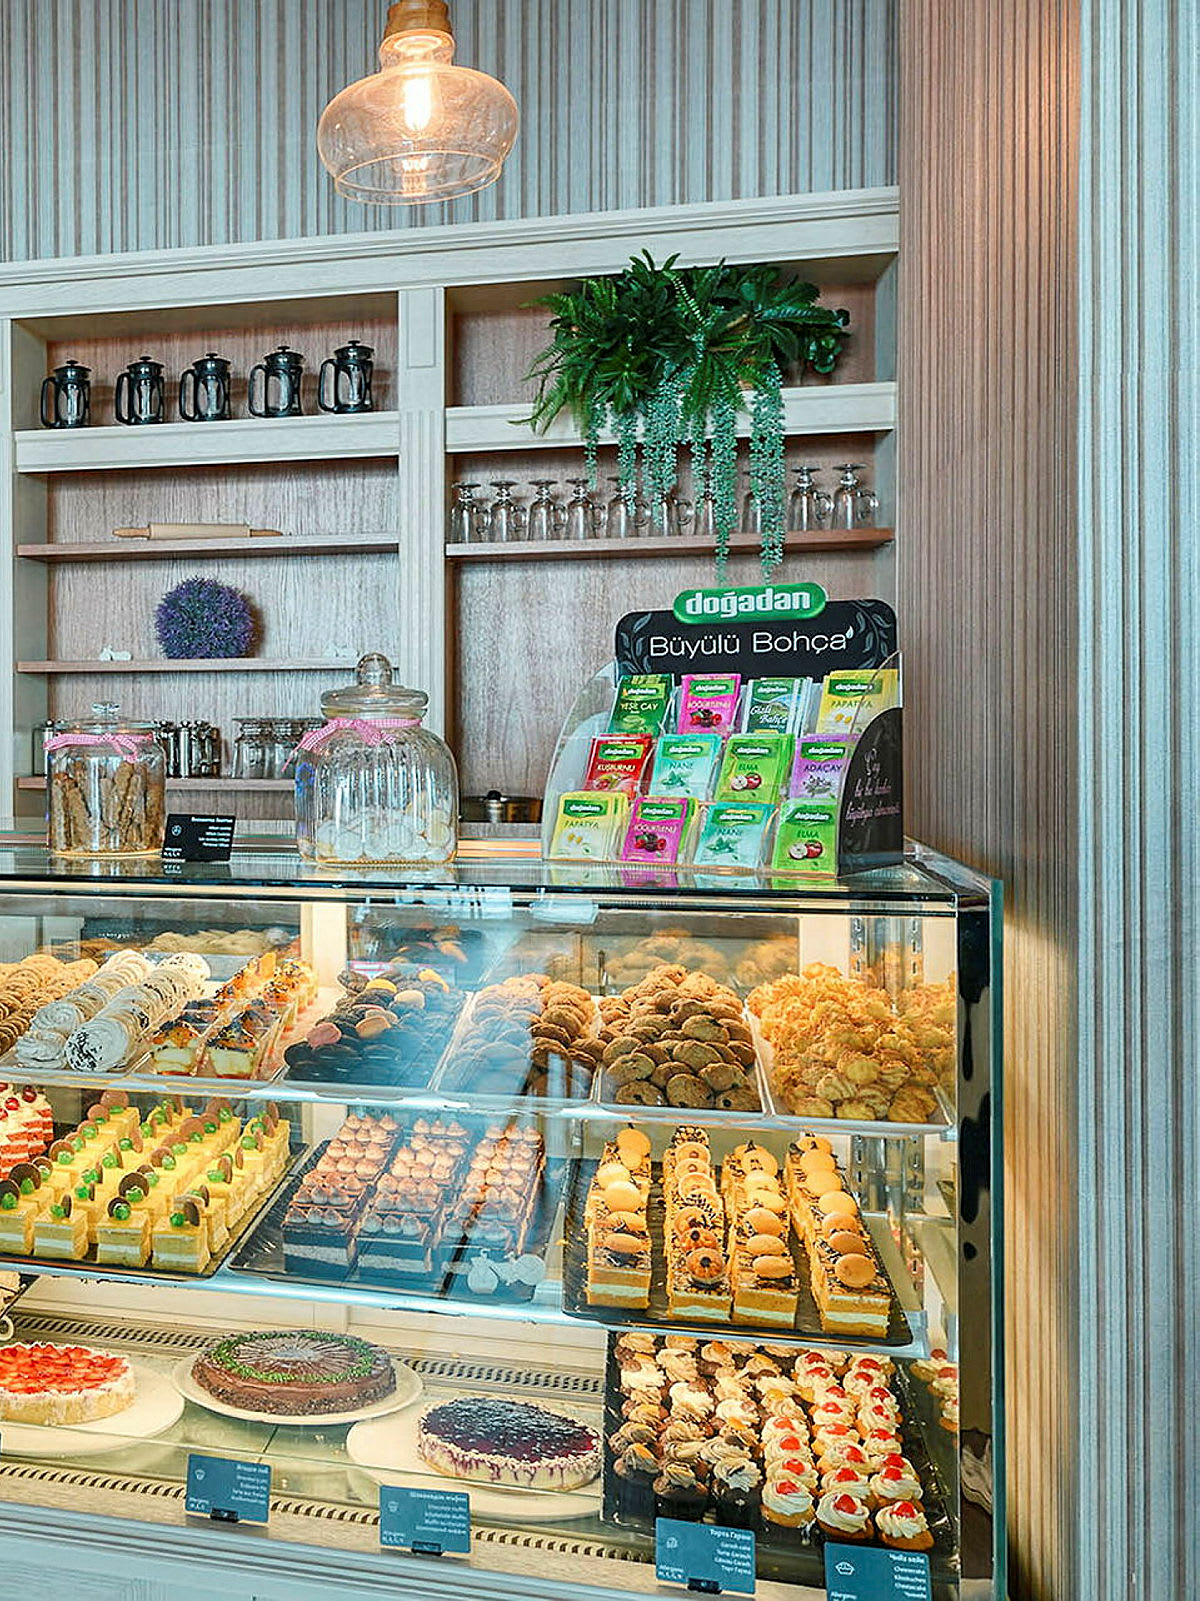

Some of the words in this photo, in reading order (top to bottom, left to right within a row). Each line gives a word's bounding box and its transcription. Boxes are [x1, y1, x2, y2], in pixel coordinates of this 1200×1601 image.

[685, 588, 811, 619] doğadan
[649, 634, 740, 660] Büyülü
[752, 631, 847, 655] Bohça
